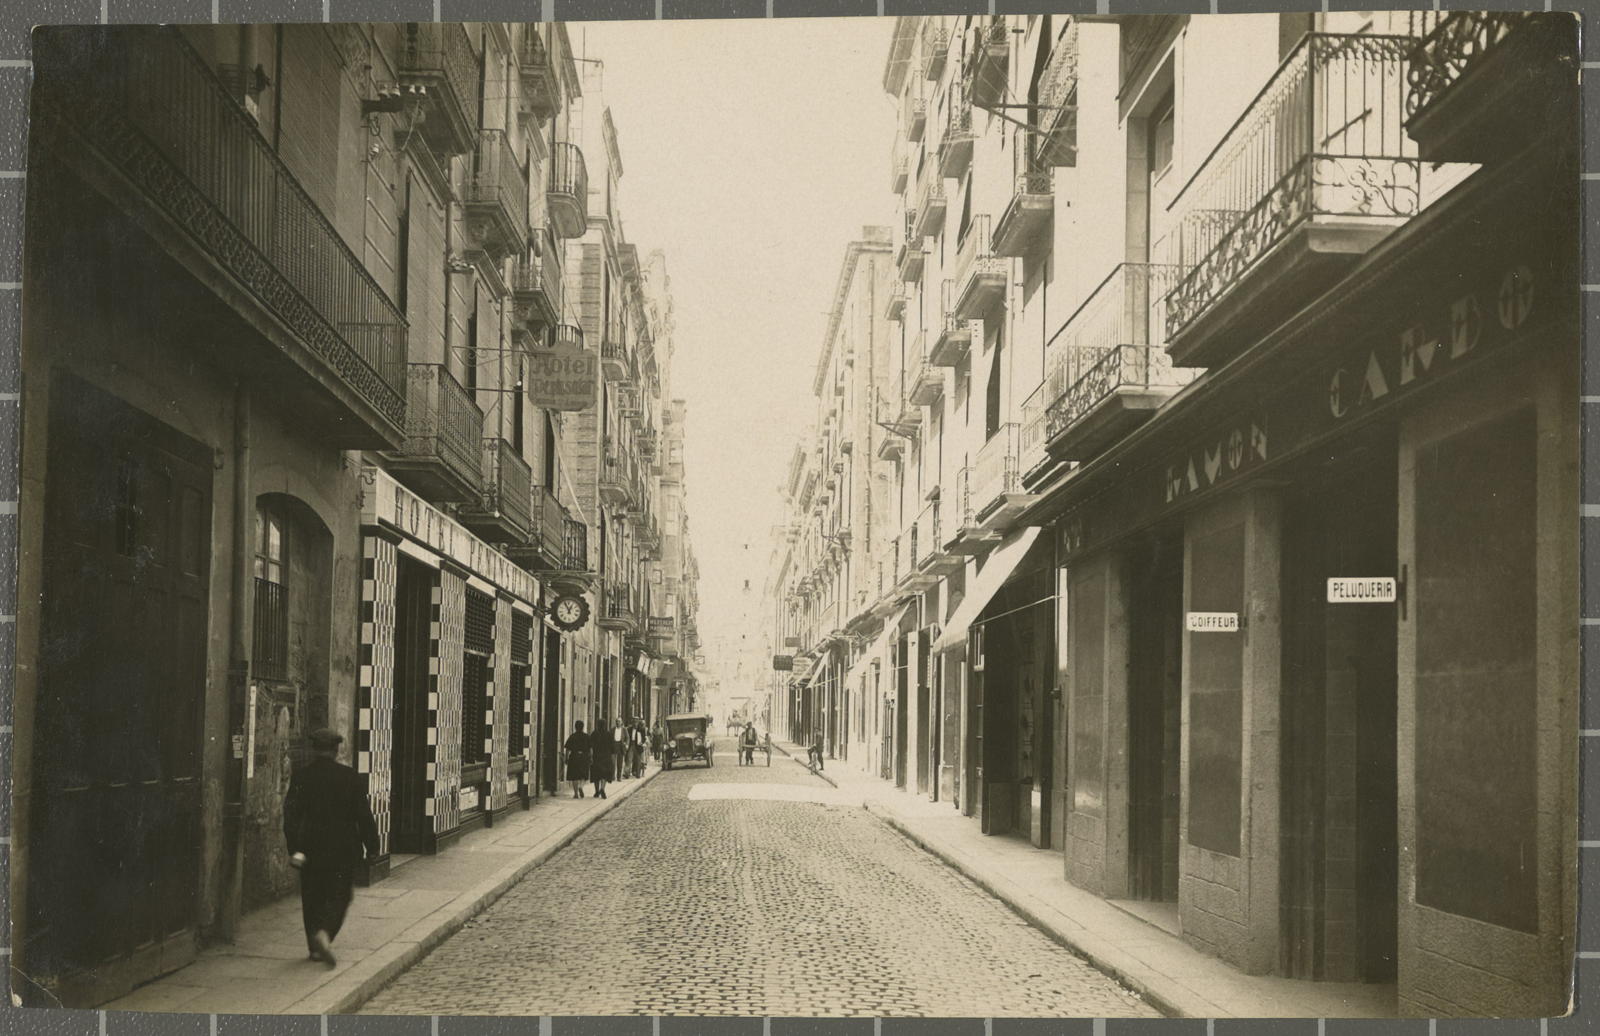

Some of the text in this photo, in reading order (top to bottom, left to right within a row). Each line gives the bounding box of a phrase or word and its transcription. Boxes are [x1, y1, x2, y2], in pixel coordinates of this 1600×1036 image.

[531, 356, 593, 376] Hotel
[1166, 265, 1534, 503] RAMON CARDO
[395, 486, 455, 557] HOTEL
[1333, 582, 1392, 599] PELUQUERIA
[1190, 616, 1236, 628] COIFFEUR
